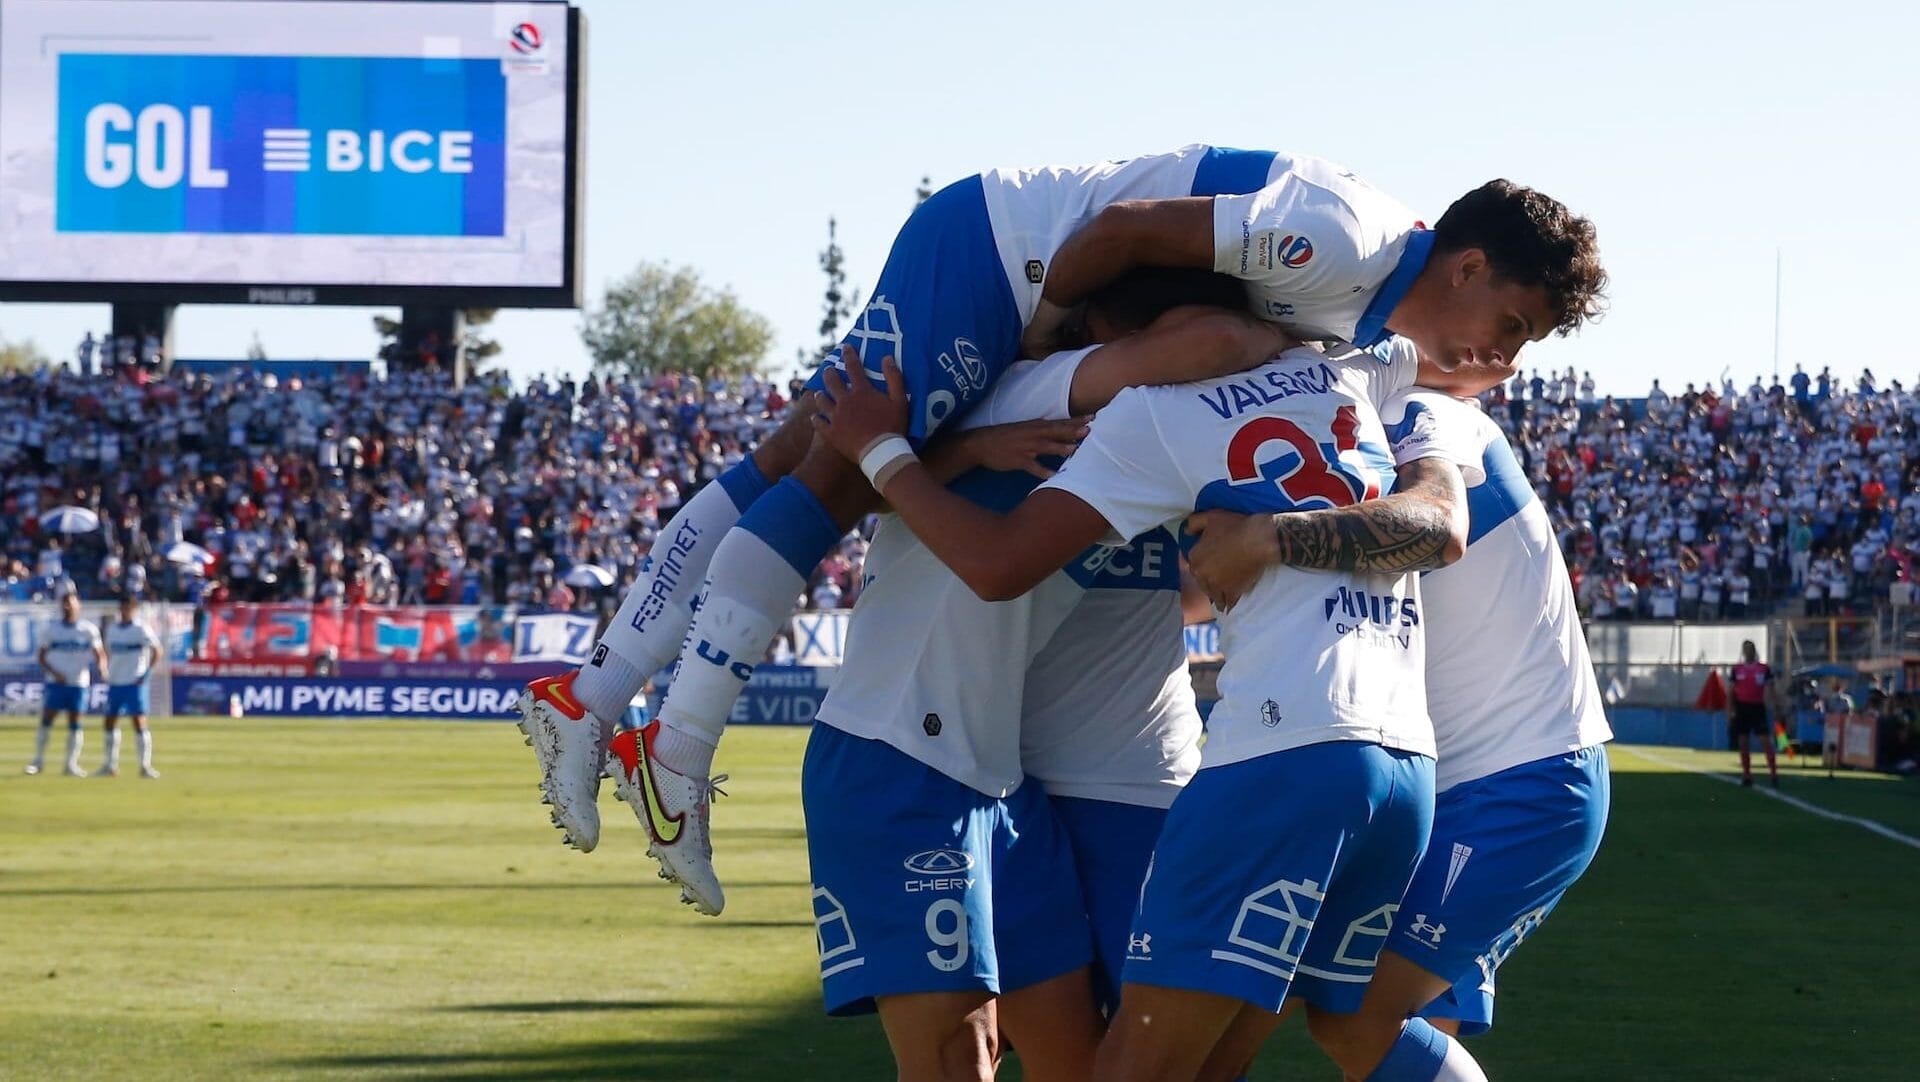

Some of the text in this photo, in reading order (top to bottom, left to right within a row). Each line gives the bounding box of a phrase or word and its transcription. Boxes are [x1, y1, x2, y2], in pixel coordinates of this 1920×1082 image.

[85, 103, 473, 189] GOL BICE
[243, 685, 284, 712] MI
[291, 685, 386, 713] PYME
[391, 686, 523, 714] SEGURA
[905, 878, 976, 892] CHERY
[925, 898, 969, 972] 9
